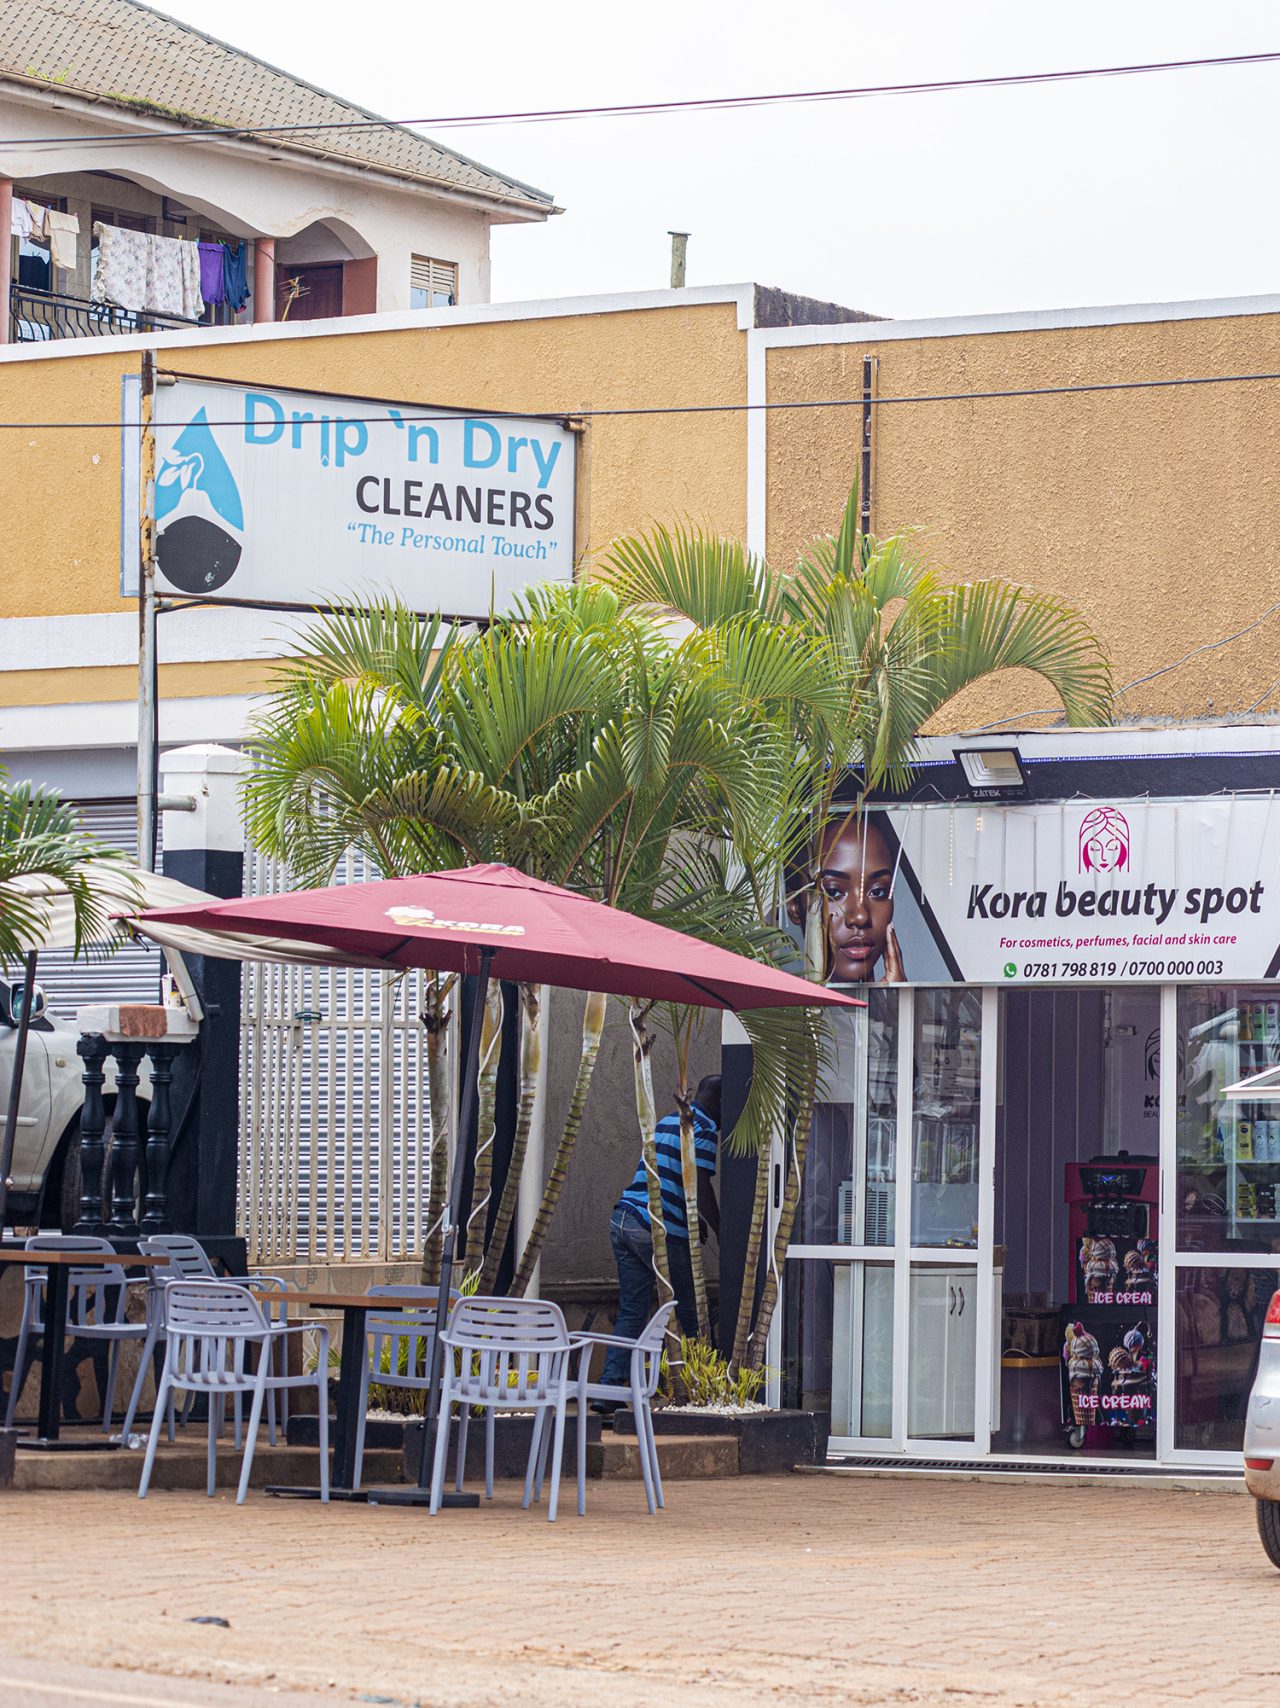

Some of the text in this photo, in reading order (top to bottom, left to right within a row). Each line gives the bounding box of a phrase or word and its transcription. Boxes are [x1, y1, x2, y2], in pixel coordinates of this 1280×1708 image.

[245, 393, 368, 468] Drip
[463, 419, 561, 489] Dry
[356, 475, 554, 530] CLEANERS
[400, 528, 485, 554] Personal
[967, 880, 1264, 926] Kora beauty spot
[1000, 933, 1237, 949] For cosmetics, perfumes, facial and skin care
[1023, 963, 1057, 978] 0781
[1061, 962, 1087, 977] 798
[1090, 962, 1117, 976] 819
[1167, 960, 1194, 975] 000
[1196, 960, 1223, 975] 003
[1093, 1292, 1113, 1304] ICE
[1078, 1394, 1151, 1409] ICE CREAM
